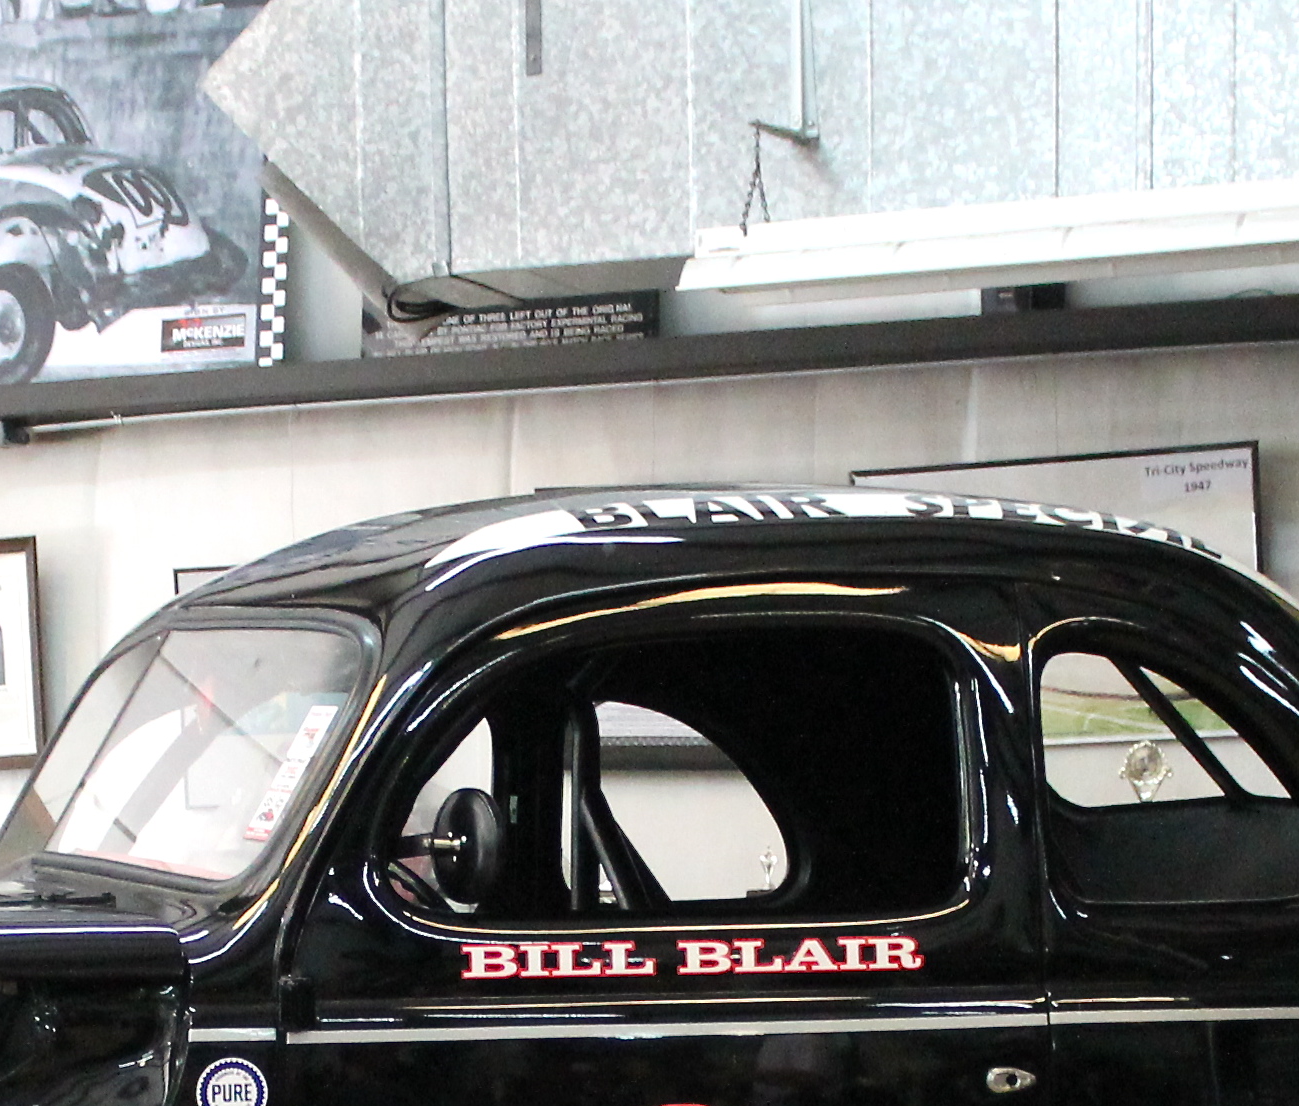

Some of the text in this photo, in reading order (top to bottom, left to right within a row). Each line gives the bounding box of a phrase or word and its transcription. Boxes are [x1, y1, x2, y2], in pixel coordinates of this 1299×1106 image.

[509, 309, 532, 321] LEFT
[534, 307, 553, 319] OUT
[555, 306, 569, 318] OF
[572, 305, 589, 317] THE
[591, 302, 632, 315] ORIGNAL
[1144, 457, 1249, 478] Tri-City Speedway
[1183, 479, 1212, 493] 1947
[580, 493, 850, 531] BLAIR
[460, 936, 926, 980] BILL BLAIR
[211, 1082, 253, 1104] PURE
